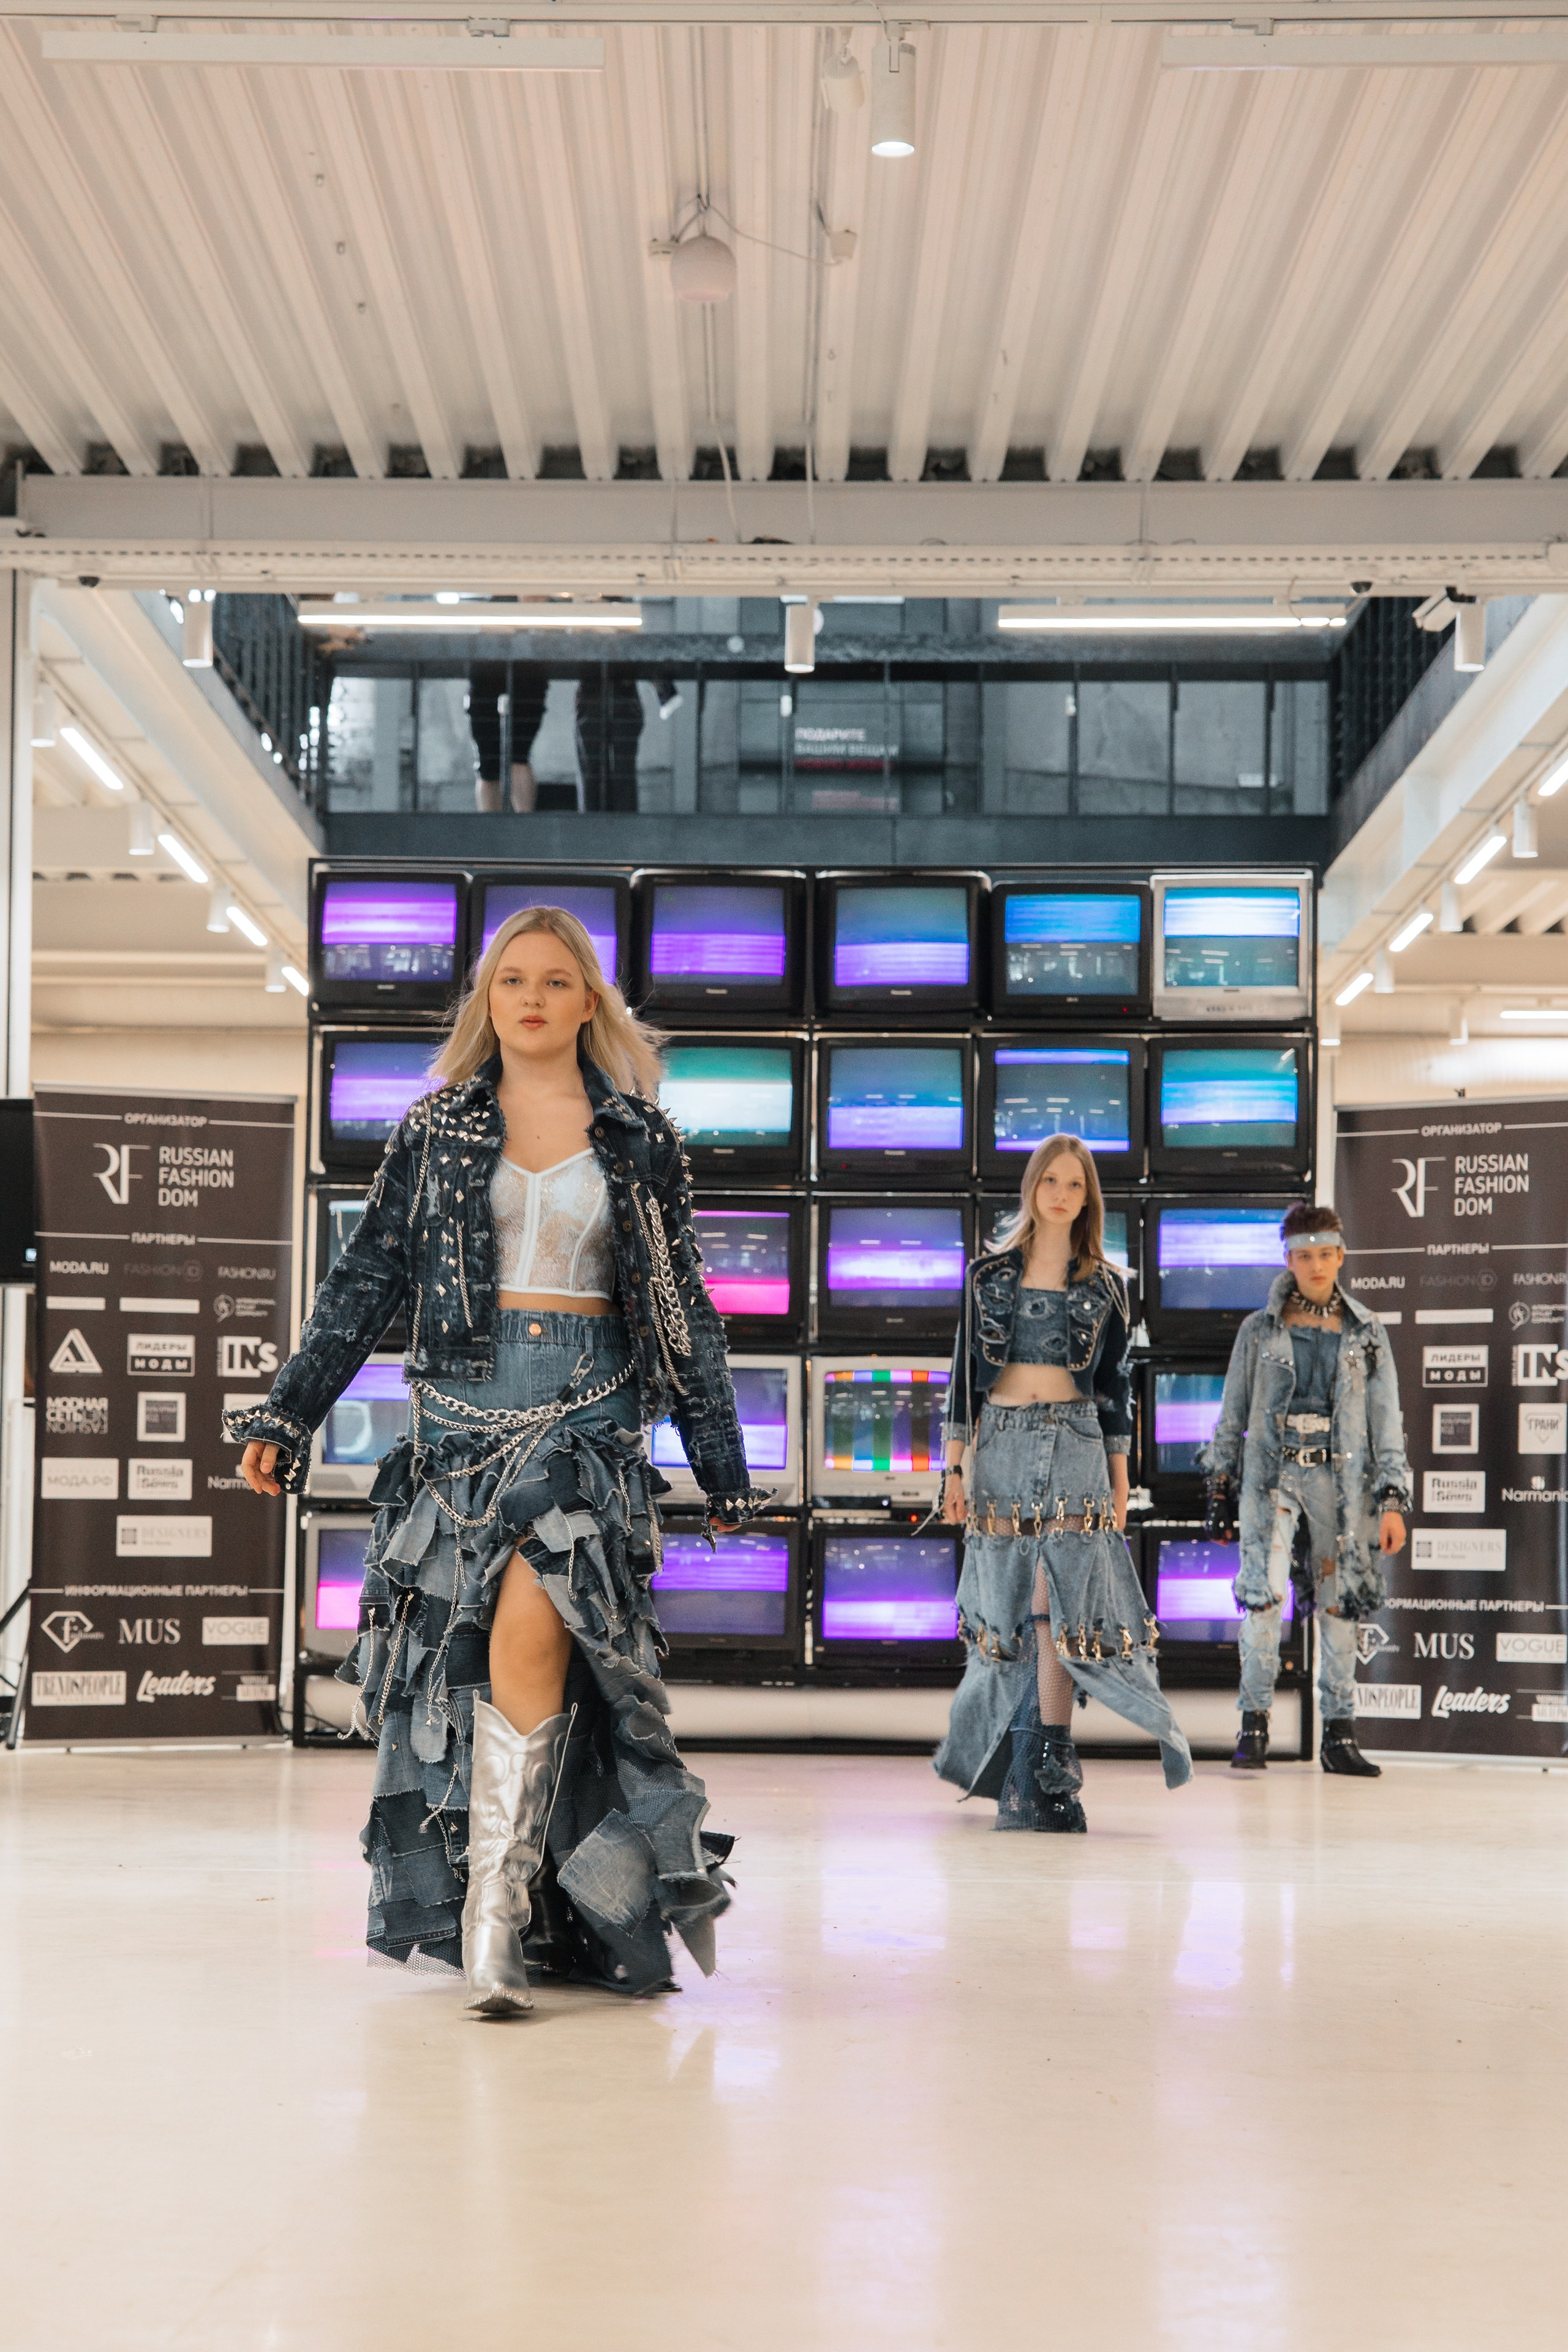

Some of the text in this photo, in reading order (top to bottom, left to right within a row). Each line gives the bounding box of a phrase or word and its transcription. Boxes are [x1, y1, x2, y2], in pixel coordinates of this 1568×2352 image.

[124, 1112, 208, 1128] ОРГАНИЗАТОР
[1422, 1122, 1502, 1137] ОРГАНИЗАТОР
[159, 1146, 233, 1167] RUSSIAN
[1455, 1153, 1529, 1174] RUSSIAN
[159, 1167, 234, 1188] FASHION
[1455, 1174, 1529, 1195] FASHION
[158, 1188, 198, 1207] DOM
[1454, 1196, 1493, 1216] DOM
[132, 1232, 195, 1246] ПАРТНЕРЫ
[1427, 1242, 1489, 1256] ПАРТНЕРЫ
[50, 1261, 109, 1275] MODA.RU
[1351, 1276, 1405, 1289] MODA.RU
[136, 1341, 187, 1351] ЛИДЕРЫ
[135, 1357, 187, 1371] МОДЫ
[1431, 1353, 1481, 1363] ЛИДЕРЫ
[1430, 1369, 1482, 1382] МОДЫ
[47, 1396, 108, 1411] МОДНАЯ
[1528, 1417, 1559, 1431] ГРАНИ
[64, 1585, 248, 1597] ИНФОРМАЦИОННЫЕ ПАРТНЕРЫ
[1384, 1597, 1544, 1612] ОРМАЦИОННЫЕ ПАРТНЕРЫ
[119, 1618, 181, 1645] MUS
[205, 1621, 265, 1636] VOGUE
[1413, 1632, 1475, 1660] MUS
[1499, 1637, 1563, 1654] VOGUE
[136, 1670, 216, 1703] Leaders
[1431, 1685, 1511, 1719] Leaders
